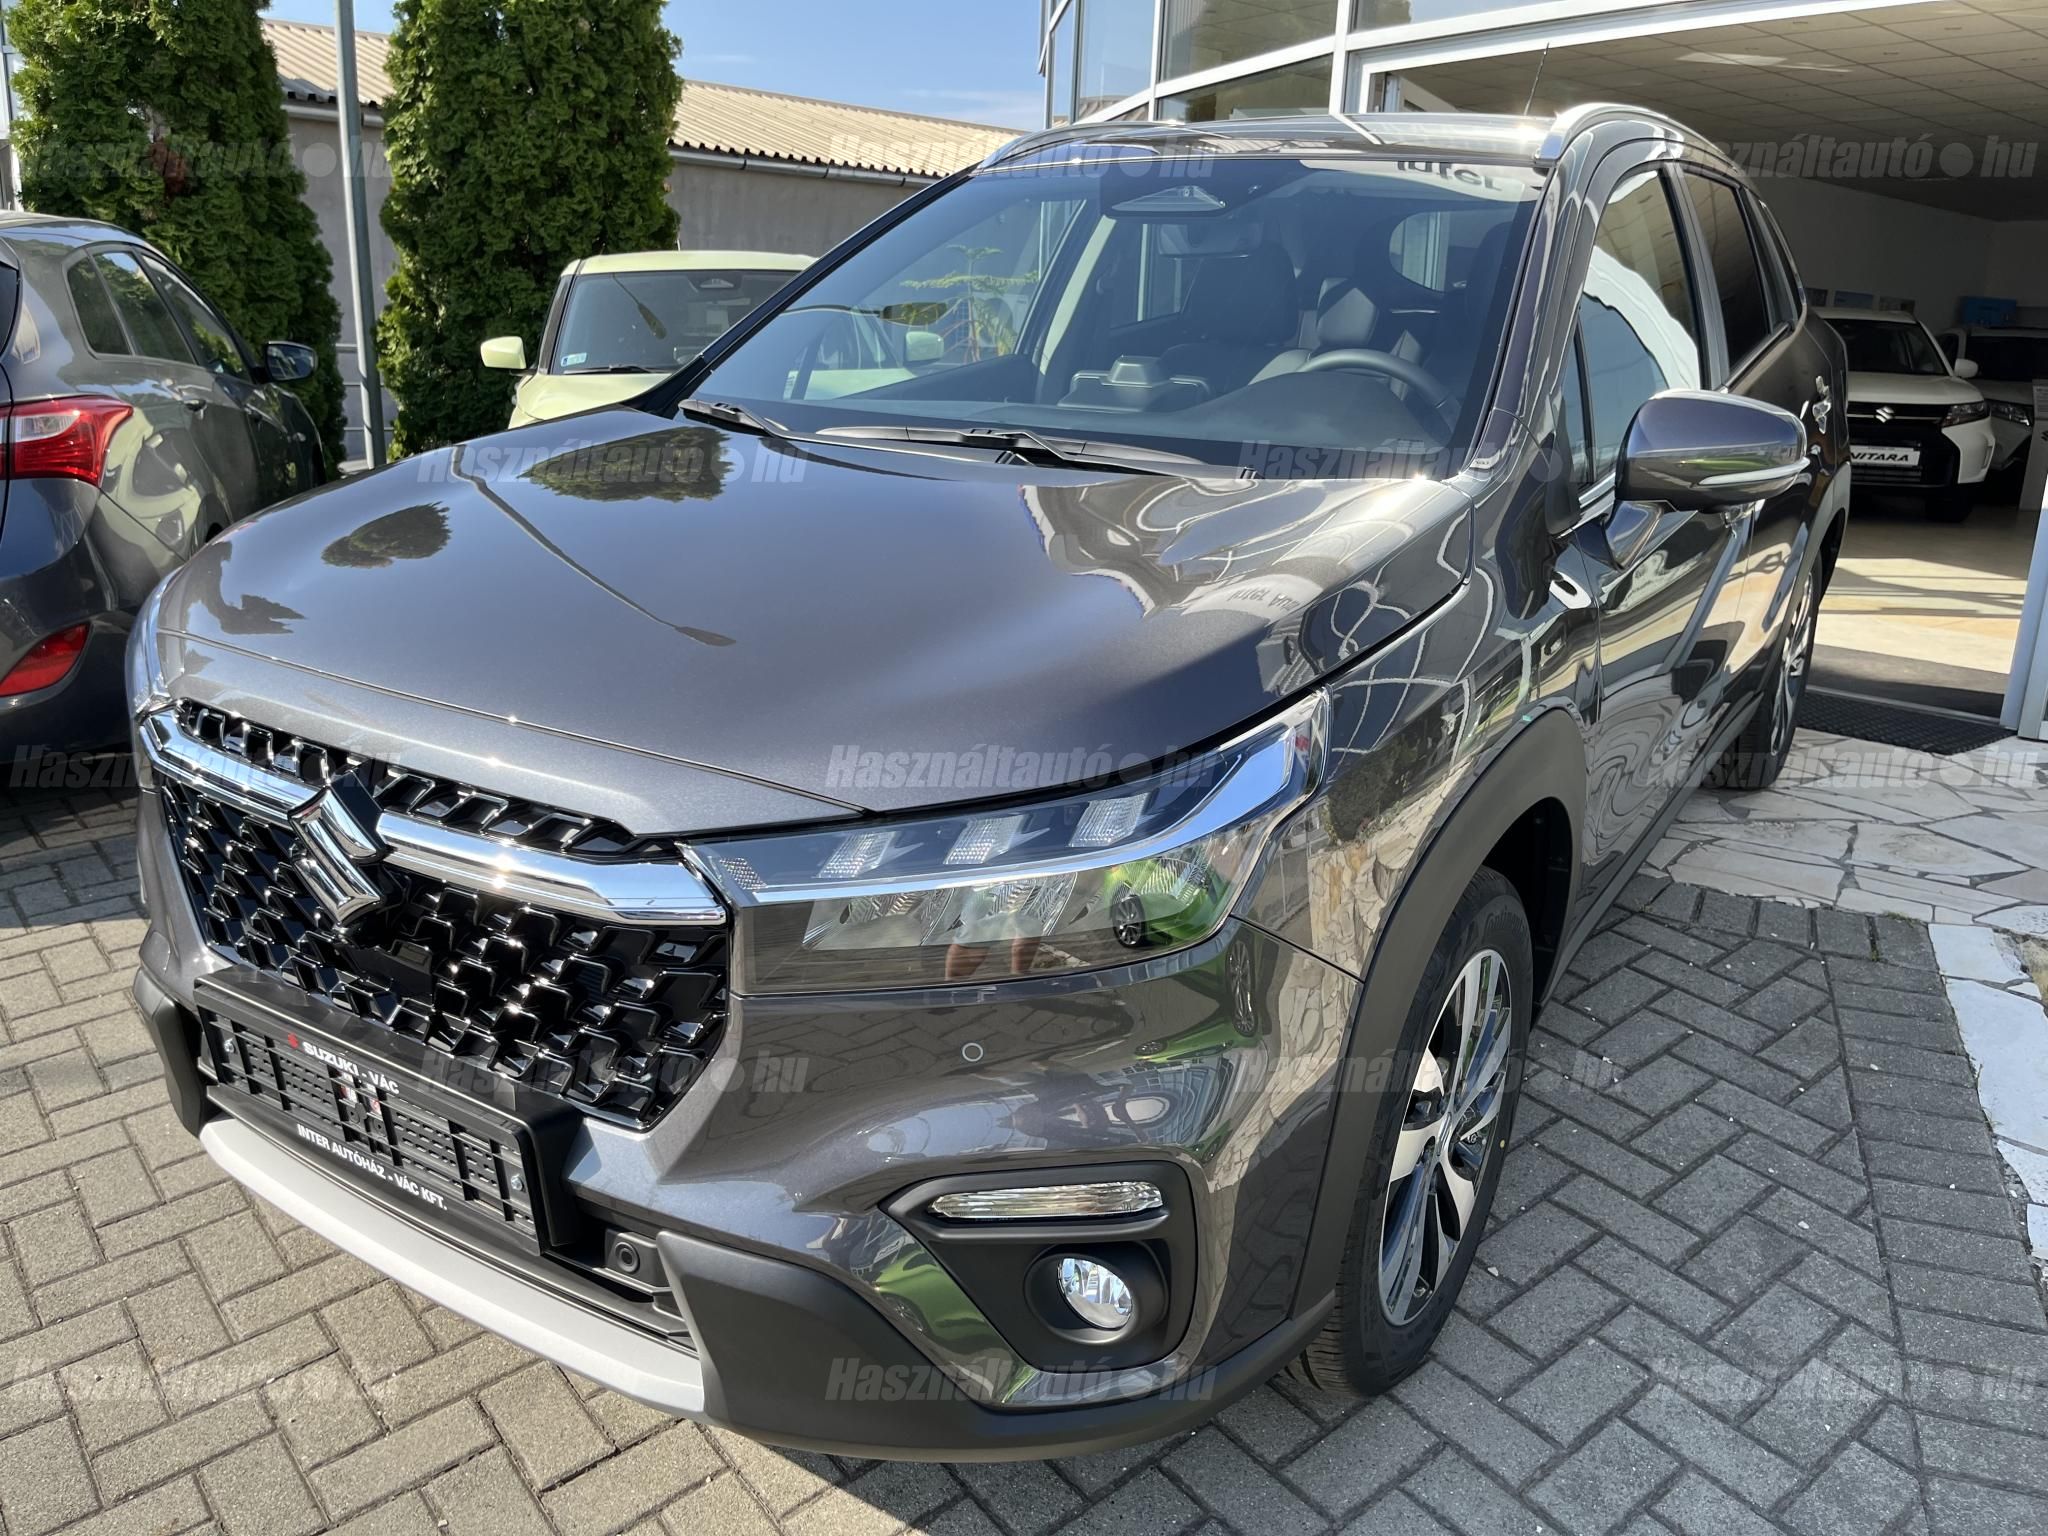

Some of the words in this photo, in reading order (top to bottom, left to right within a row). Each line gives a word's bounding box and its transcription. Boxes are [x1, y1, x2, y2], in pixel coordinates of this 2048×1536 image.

[1850, 452, 1909, 462] VITARA
[302, 1041, 359, 1077] SUZUKI
[367, 1069, 400, 1095] VÁC
[296, 1123, 331, 1151] INTER
[331, 1141, 387, 1180] AUTÓHÁZ
[394, 1172, 420, 1196] VÁC
[420, 1186, 448, 1211] KFT.
